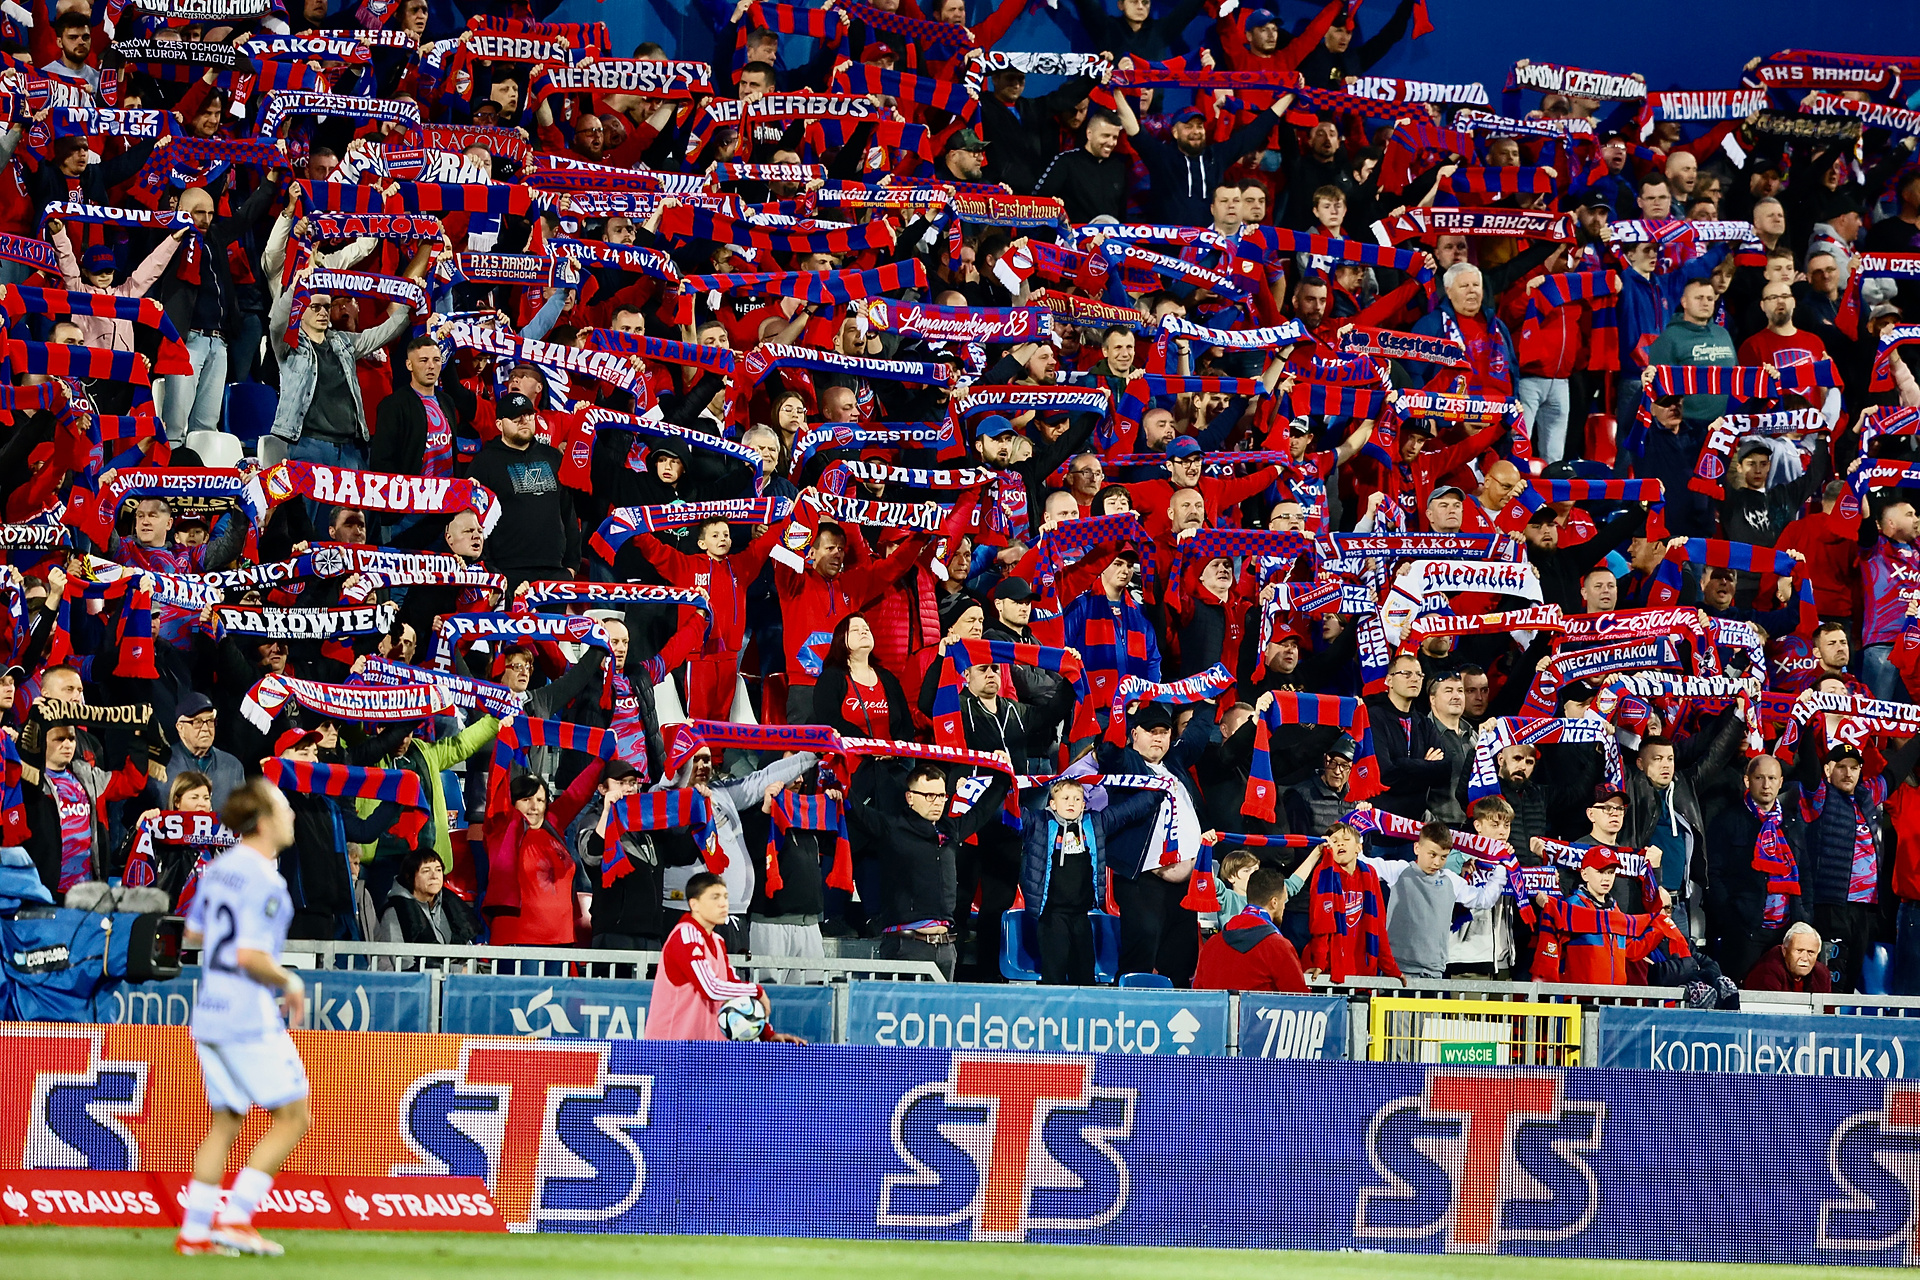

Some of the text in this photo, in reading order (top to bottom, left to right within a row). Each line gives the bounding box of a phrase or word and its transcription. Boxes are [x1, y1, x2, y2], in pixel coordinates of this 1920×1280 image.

[146, 48, 188, 61] EUROPA
[191, 49, 236, 67] LEAGUE
[249, 35, 356, 57] RAKÓW
[548, 68, 677, 94] HERBUSY
[1660, 91, 1727, 120] MEDALIKI
[1434, 215, 1475, 229] RKS
[603, 247, 621, 264] ZA
[899, 306, 1029, 343] Limanowskiego 83
[109, 471, 158, 498] RAKÓW
[311, 465, 451, 511] RAKÓW
[1346, 537, 1476, 550] RKS RAKÓW
[1462, 549, 1485, 557] JEST
[694, 573, 711, 586] 1921
[1423, 561, 1527, 592] Medaliki
[453, 615, 567, 636] RAKÓW
[1554, 650, 1609, 675] WIECZNY
[1613, 642, 1658, 661] RAKÓW
[1445, 1046, 1493, 1063] WYJŚCIE
[1650, 1024, 1879, 1078] komplexdruk
[391, 1040, 653, 1232] STS
[878, 1052, 1139, 1242] STS
[1353, 1065, 1607, 1255] STS
[31, 1189, 161, 1215] STRAUSS
[371, 1194, 494, 1216] STRAUSS
